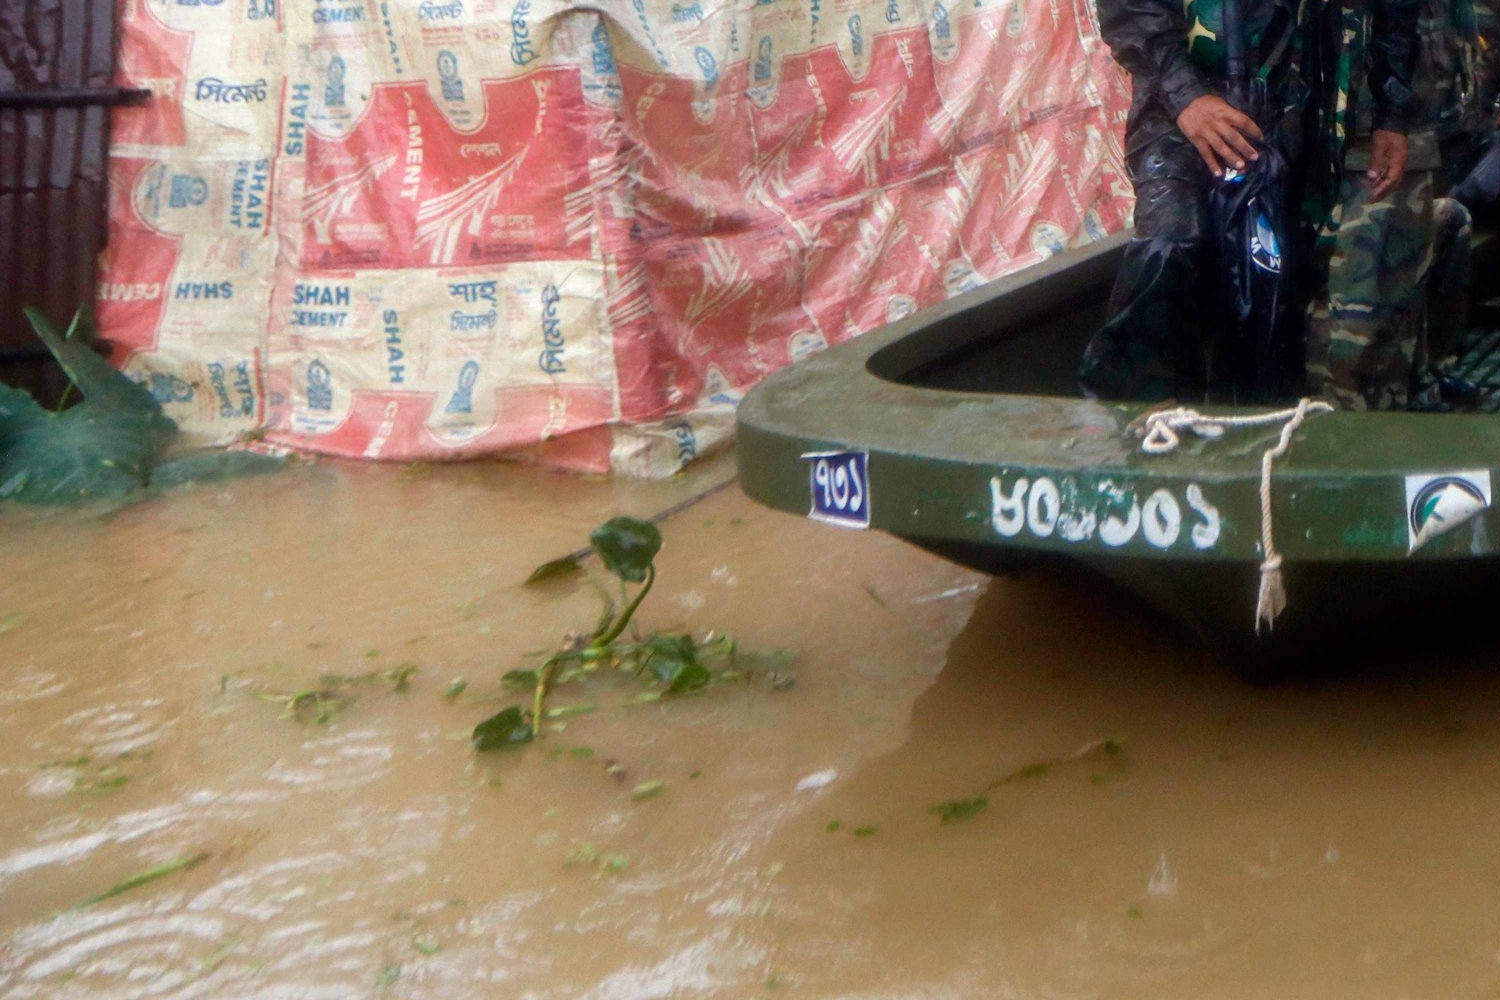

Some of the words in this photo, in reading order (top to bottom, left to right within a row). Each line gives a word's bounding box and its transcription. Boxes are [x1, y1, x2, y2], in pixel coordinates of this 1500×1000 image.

[195, 76, 267, 103] সিমেন্ট
[285, 84, 310, 155] SHAH
[400, 90, 424, 201] CEMENT
[247, 158, 268, 229] SHAH
[175, 281, 234, 299] SHAH
[293, 283, 350, 306] SHAH
[447, 280, 498, 308] শাহ
[383, 309, 404, 384] SHAH
[539, 284, 567, 376] সিমেন্ট
